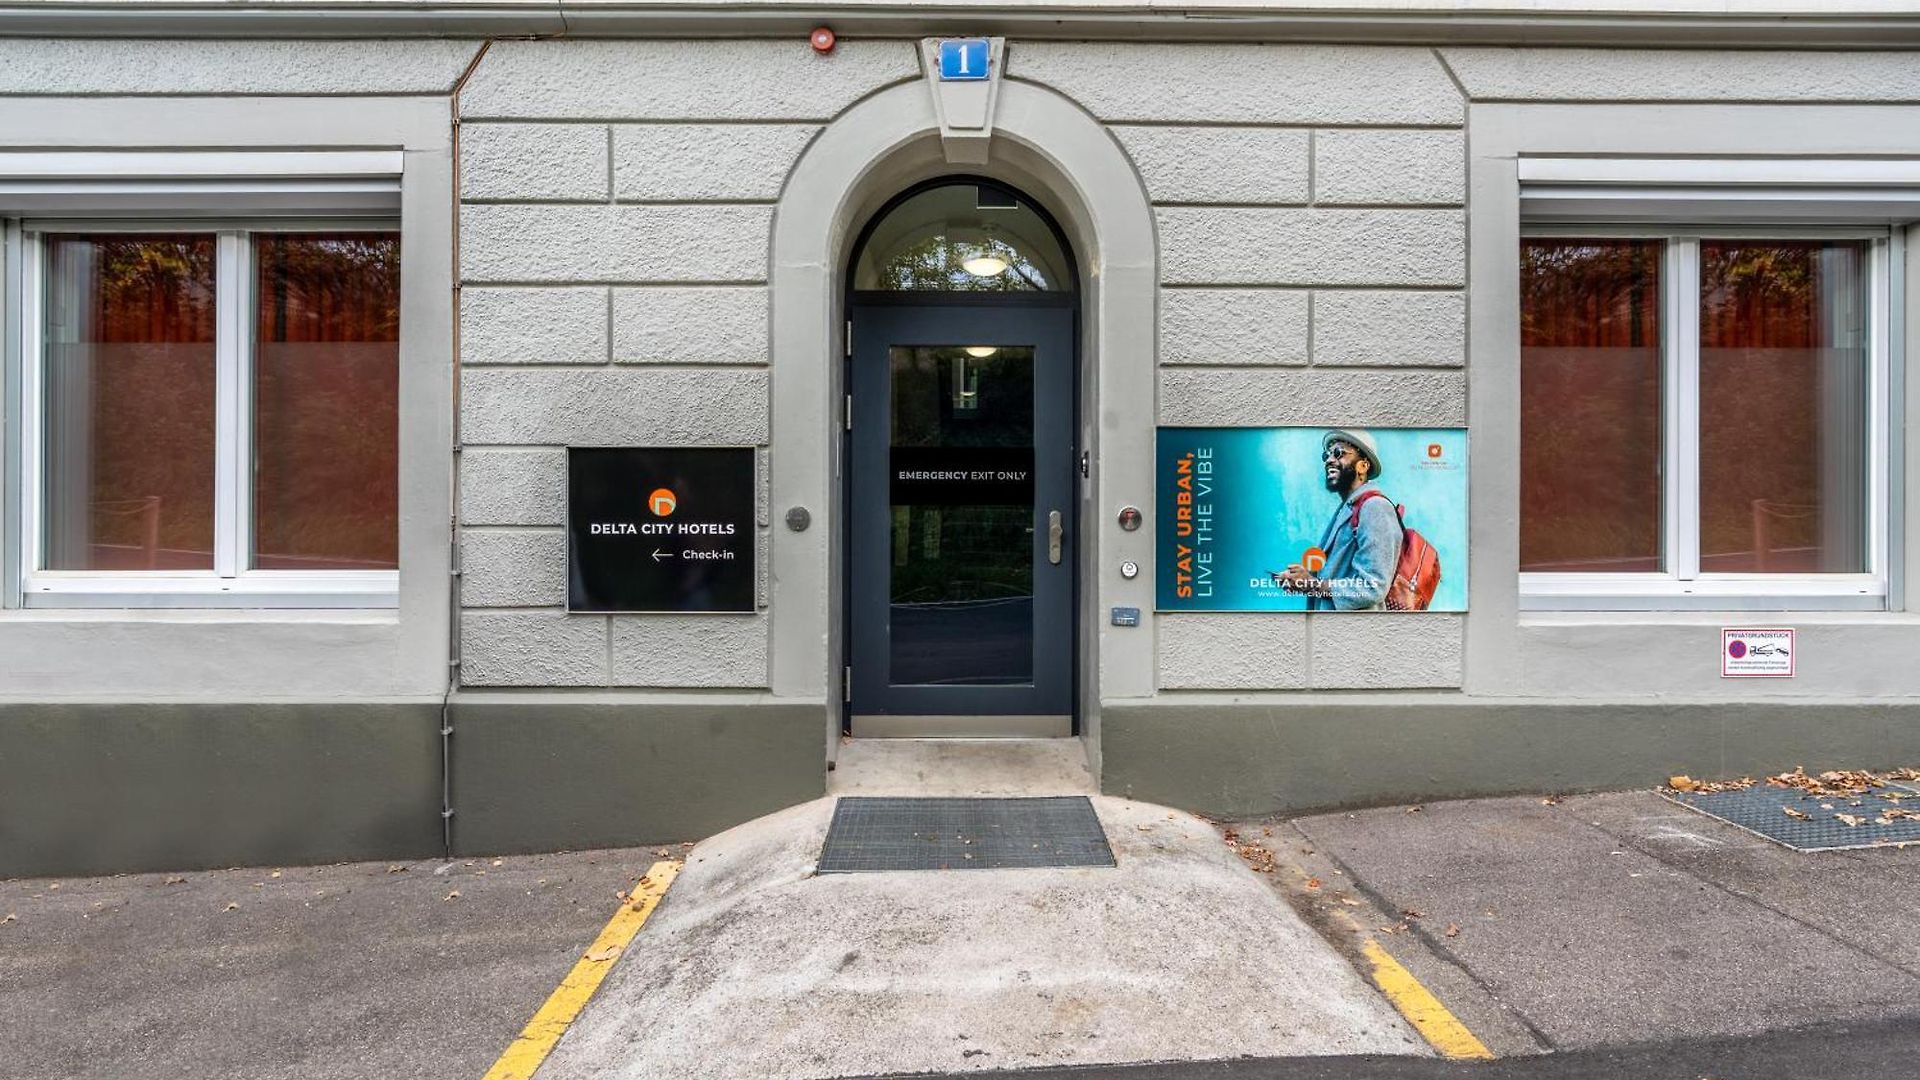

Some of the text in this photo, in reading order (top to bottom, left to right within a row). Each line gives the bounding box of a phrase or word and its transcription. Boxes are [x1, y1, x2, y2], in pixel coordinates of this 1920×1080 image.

[958, 44, 970, 74] 1
[898, 471, 1027, 480] EMERGENCY EXIT ONLY
[1177, 452, 1195, 599] STAY URBAN,
[1197, 447, 1213, 597] LIVE THE VIBE
[591, 523, 735, 535] DELTA CITY HOTELS
[682, 549, 735, 560] Check-in
[1249, 577, 1378, 588] DELTA CITY HOTELS
